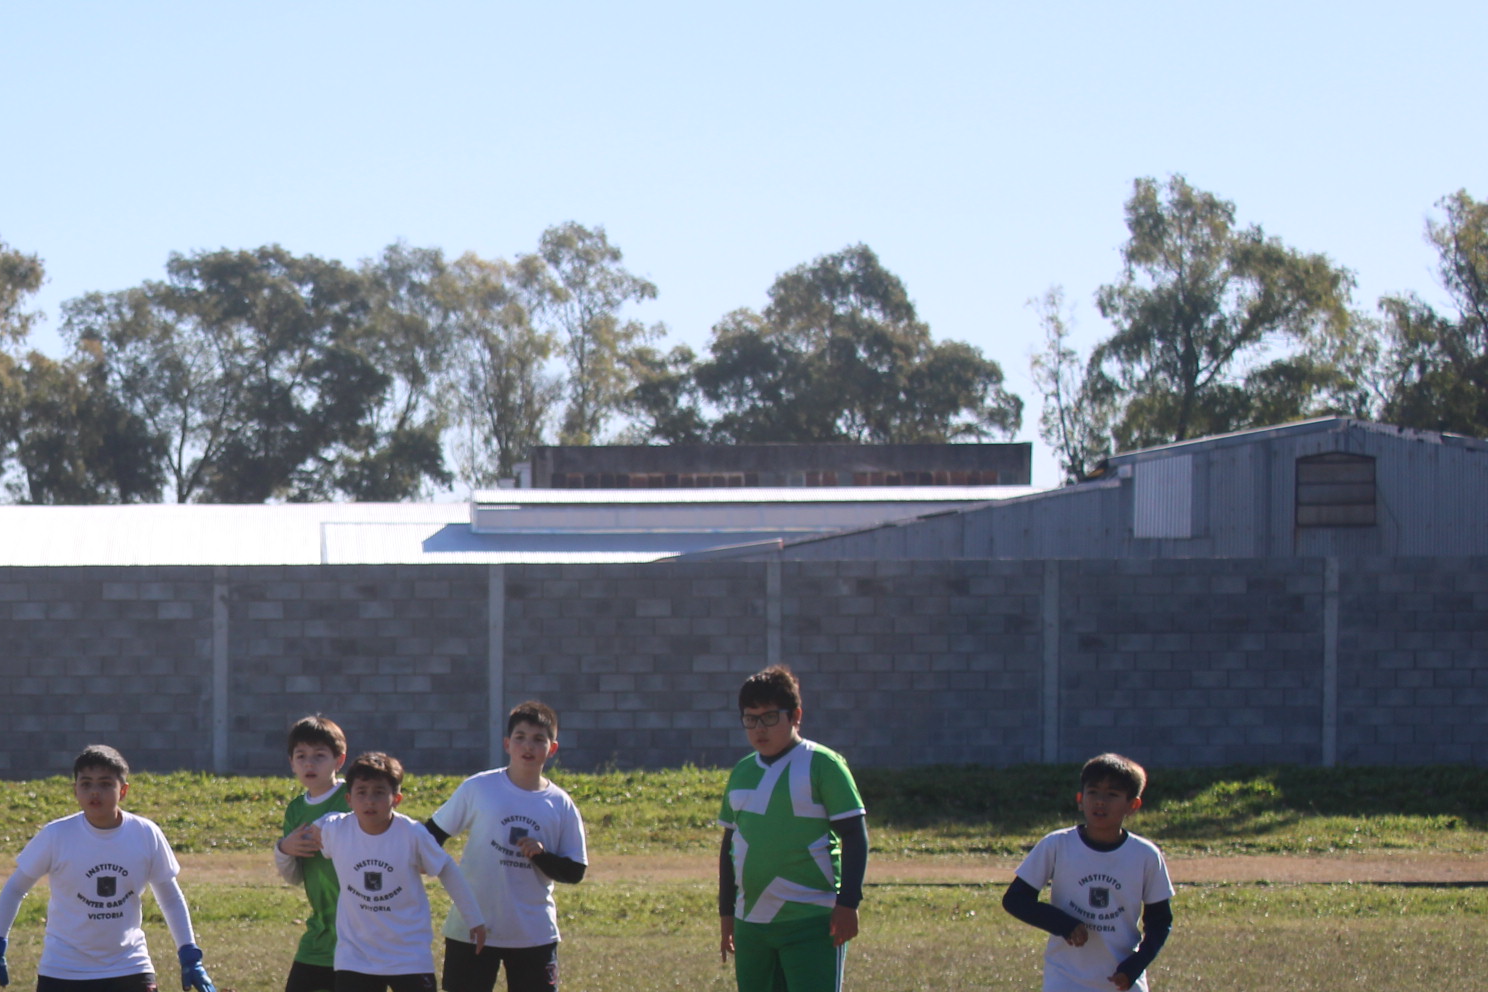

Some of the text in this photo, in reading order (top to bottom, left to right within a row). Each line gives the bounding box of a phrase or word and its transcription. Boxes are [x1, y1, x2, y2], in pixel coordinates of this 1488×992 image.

[501, 815, 540, 832] INSTITUTO
[85, 863, 129, 878] INSTITUTO
[353, 859, 394, 873] INSTITUTO
[499, 860, 532, 869] VICTORIA
[1078, 874, 1122, 890] INSTITUTO
[76, 892, 104, 908] WINTER
[346, 884, 403, 902] WINTER GARDEN
[87, 912, 124, 920] VICTORIA
[1069, 900, 1096, 920] WINTER
[1085, 923, 1116, 932] ICTORIA
